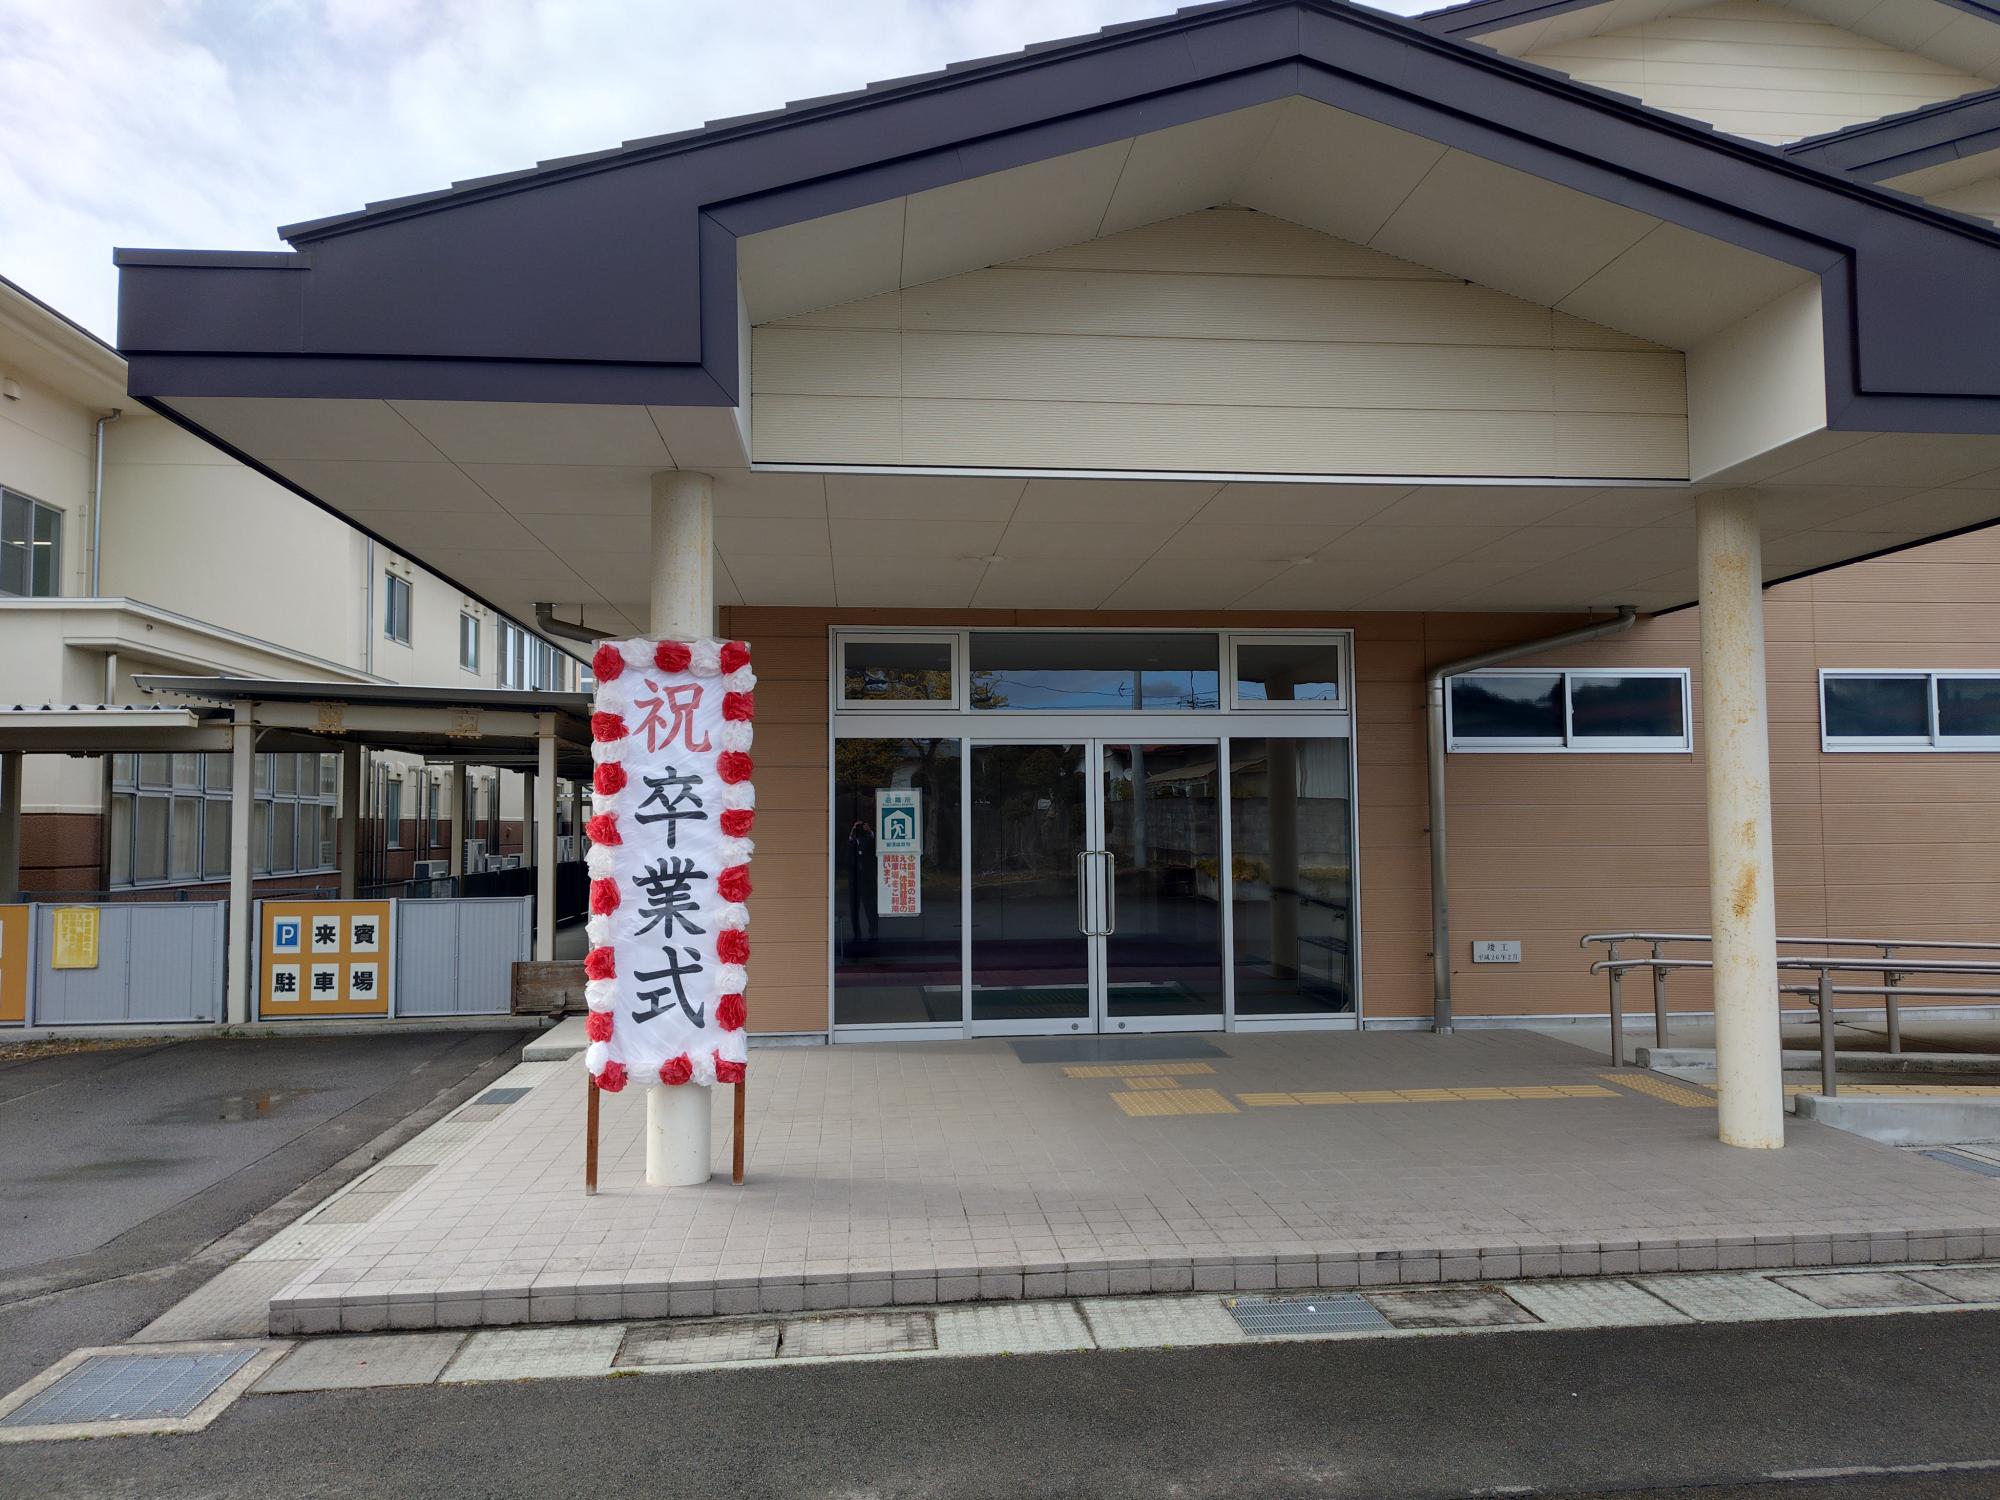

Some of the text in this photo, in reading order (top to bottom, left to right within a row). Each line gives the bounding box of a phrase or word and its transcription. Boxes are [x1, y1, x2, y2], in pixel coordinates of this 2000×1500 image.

[280, 924, 375, 945] P 来賓
[274, 971, 374, 992] 駐車場
